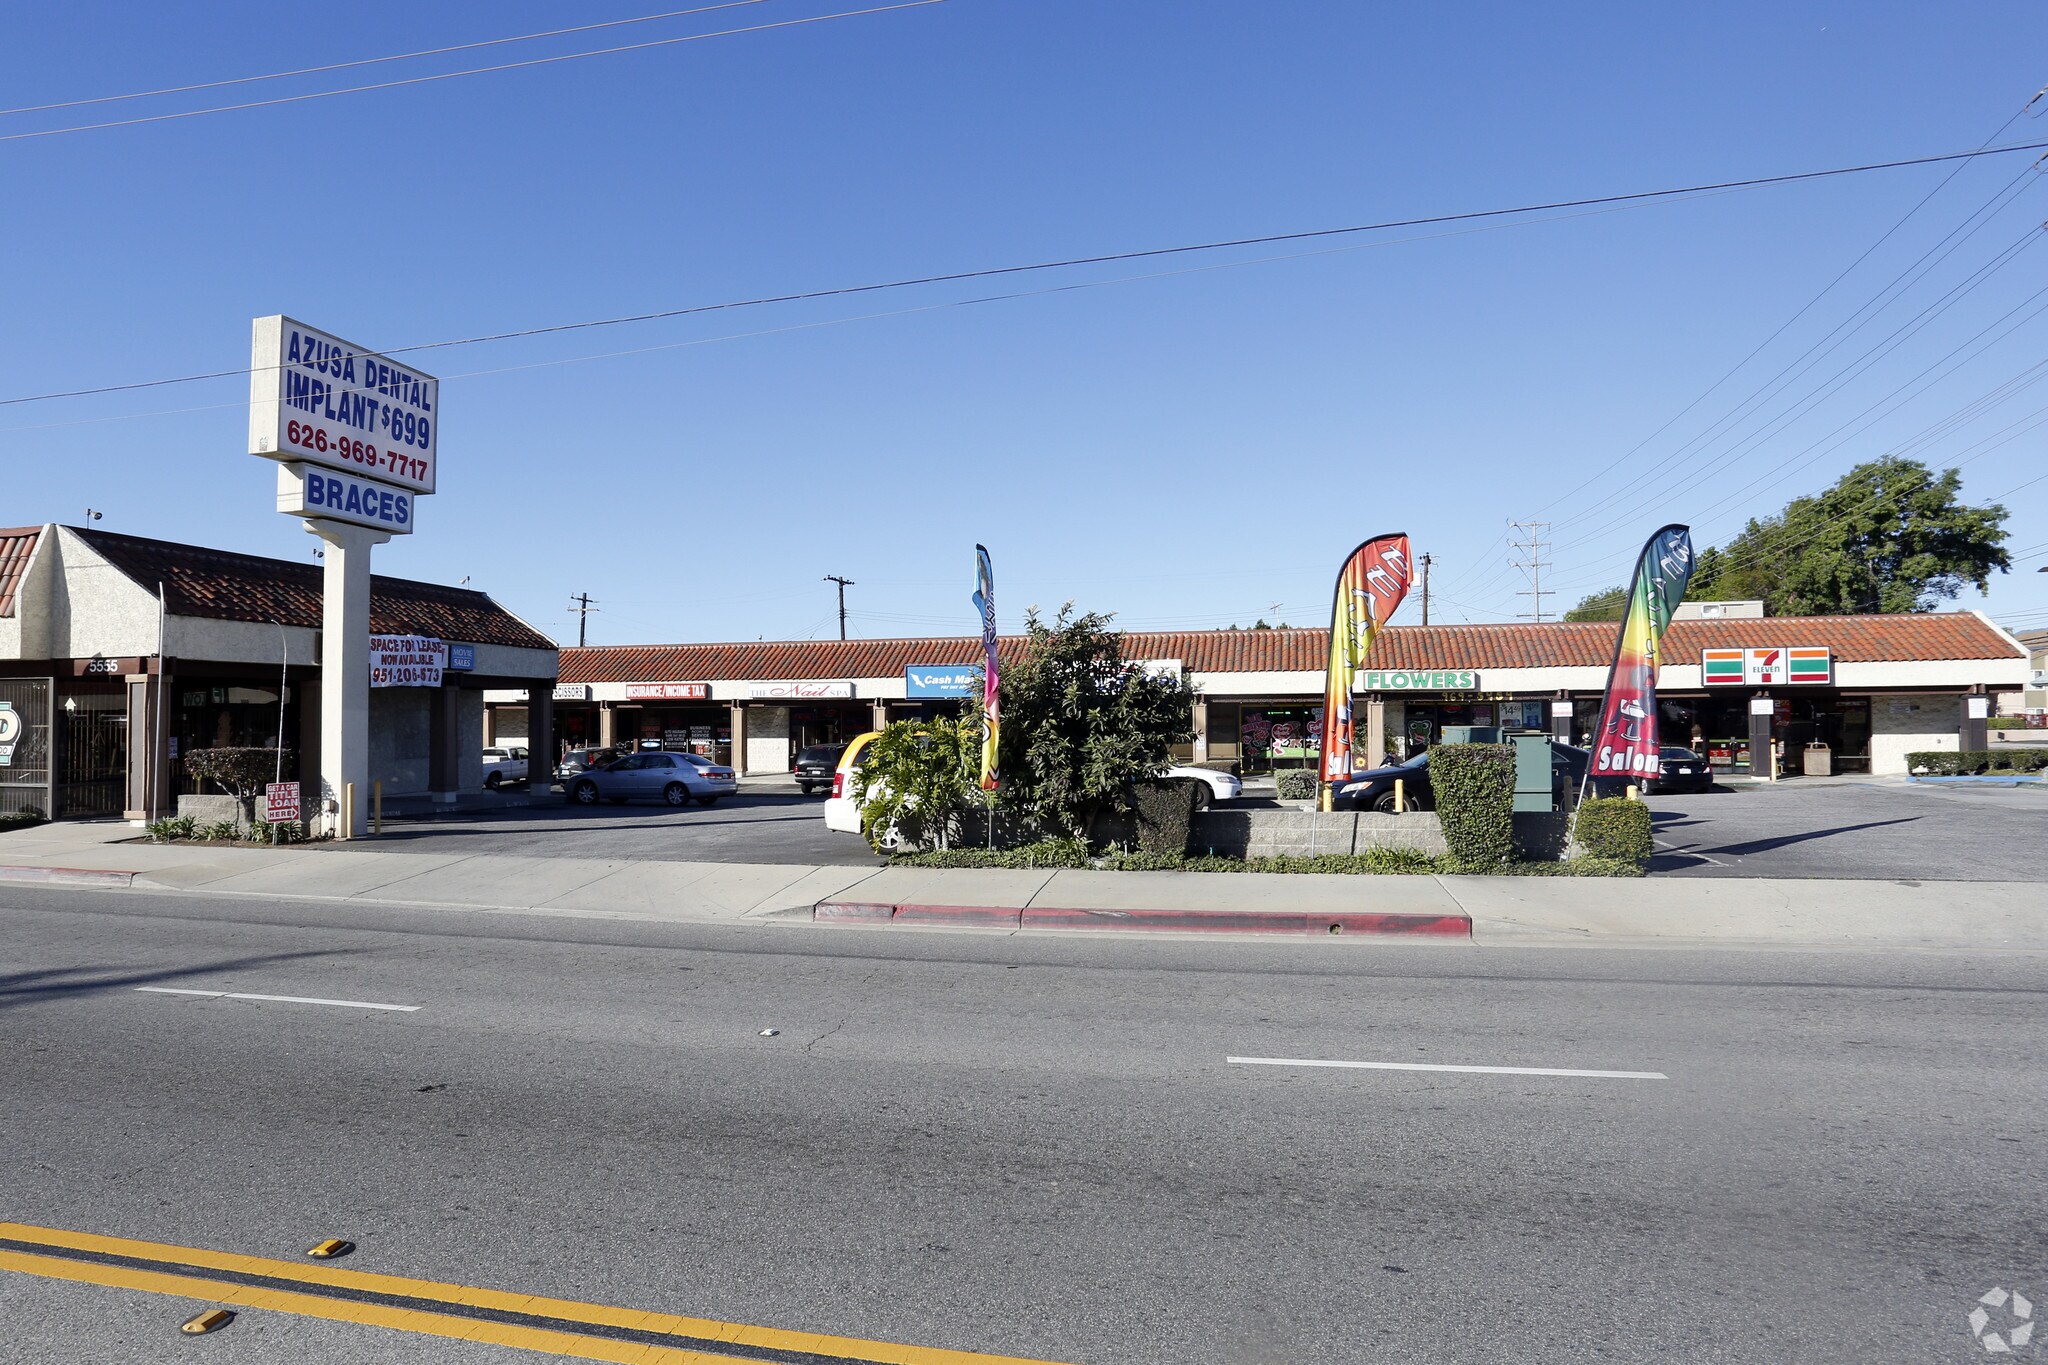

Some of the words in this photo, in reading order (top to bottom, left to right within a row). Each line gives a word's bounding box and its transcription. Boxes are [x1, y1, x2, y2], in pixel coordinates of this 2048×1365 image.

[288, 331, 355, 383] AZUSA
[365, 359, 431, 412] DENTAL
[286, 370, 379, 432] IMPLANT
[382, 404, 430, 450] $699
[287, 420, 428, 481] 626-969-7717
[308, 473, 409, 524] BRACES
[370, 638, 400, 652] SPACE
[453, 648, 473, 657] MOVIE
[90, 659, 118, 673] 5555
[1753, 650, 1779, 682] 7
[924, 675, 952, 685] Cash
[1368, 673, 1472, 689] FLOWERS
[553, 686, 583, 697] SCISSORS
[692, 685, 705, 697] TAX
[770, 683, 830, 697] Nail
[1599, 746, 1659, 773] Salon
[268, 791, 298, 800] TITLE
[268, 798, 298, 808] LOAN
